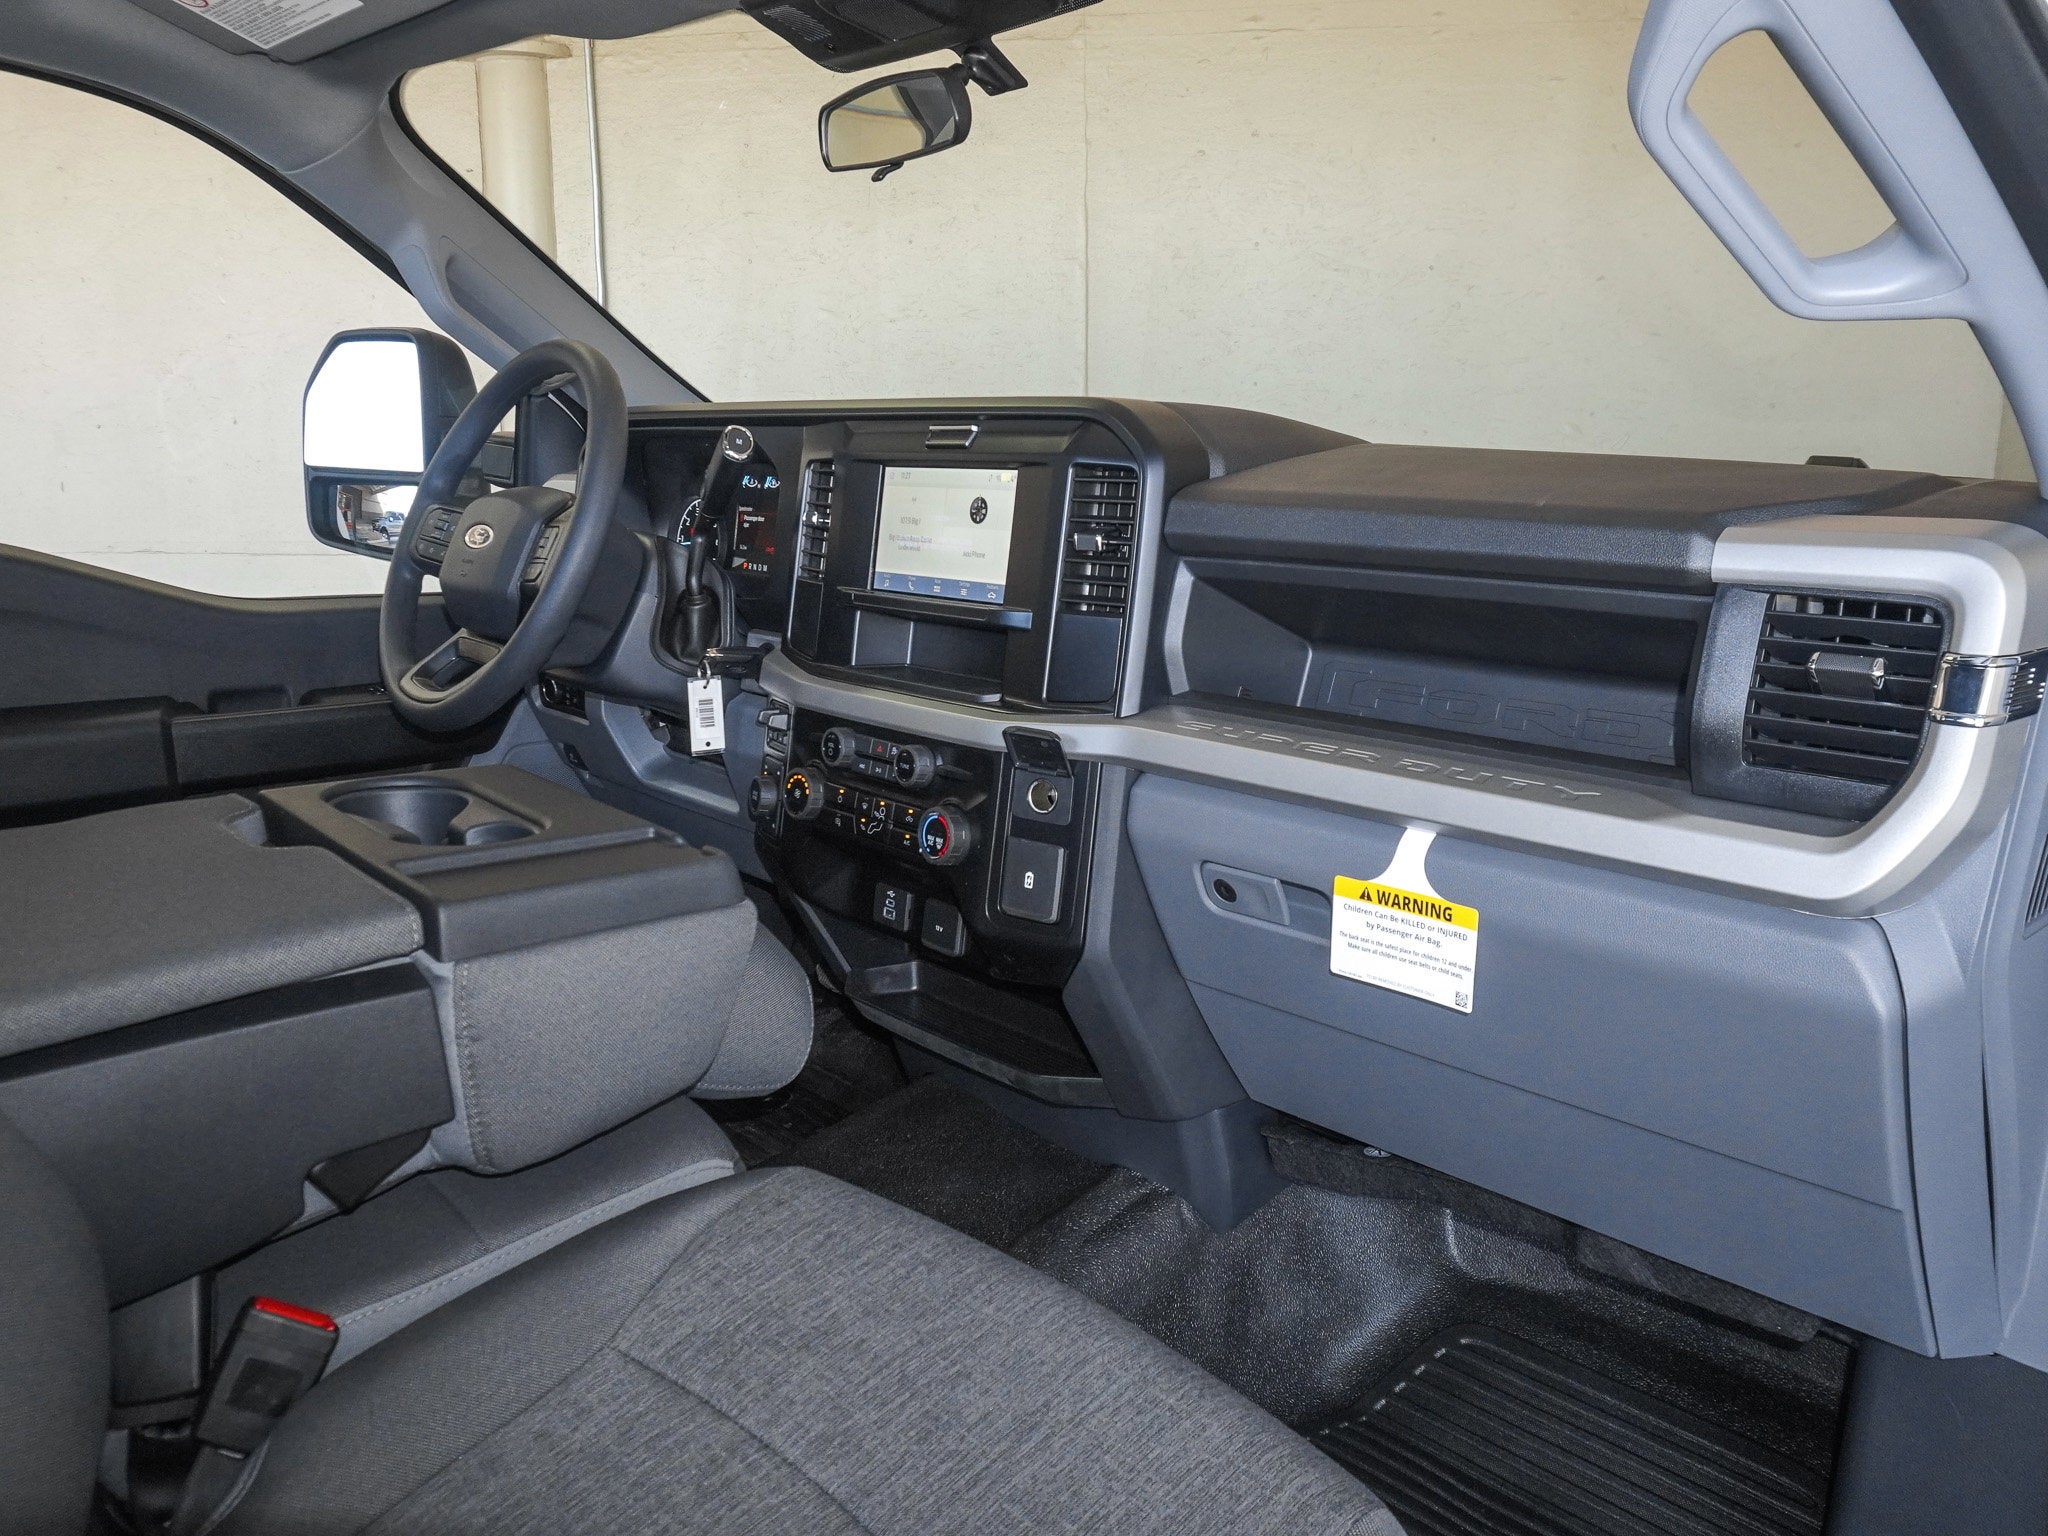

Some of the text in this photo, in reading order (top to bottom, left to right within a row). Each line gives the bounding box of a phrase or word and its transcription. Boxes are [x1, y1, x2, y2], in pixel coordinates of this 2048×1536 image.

[1176, 721, 1602, 800] SUPER DUTY
[1343, 903, 1373, 916] Children
[1374, 910, 1388, 920] Can
[1389, 914, 1399, 923] Be
[1400, 917, 1426, 930] KILLED
[1437, 926, 1468, 941] INJURED
[1376, 889, 1453, 923] WARNING
[1366, 921, 1375, 931] by
[1376, 923, 1413, 939] Passenger
[1414, 933, 1425, 942] Air
